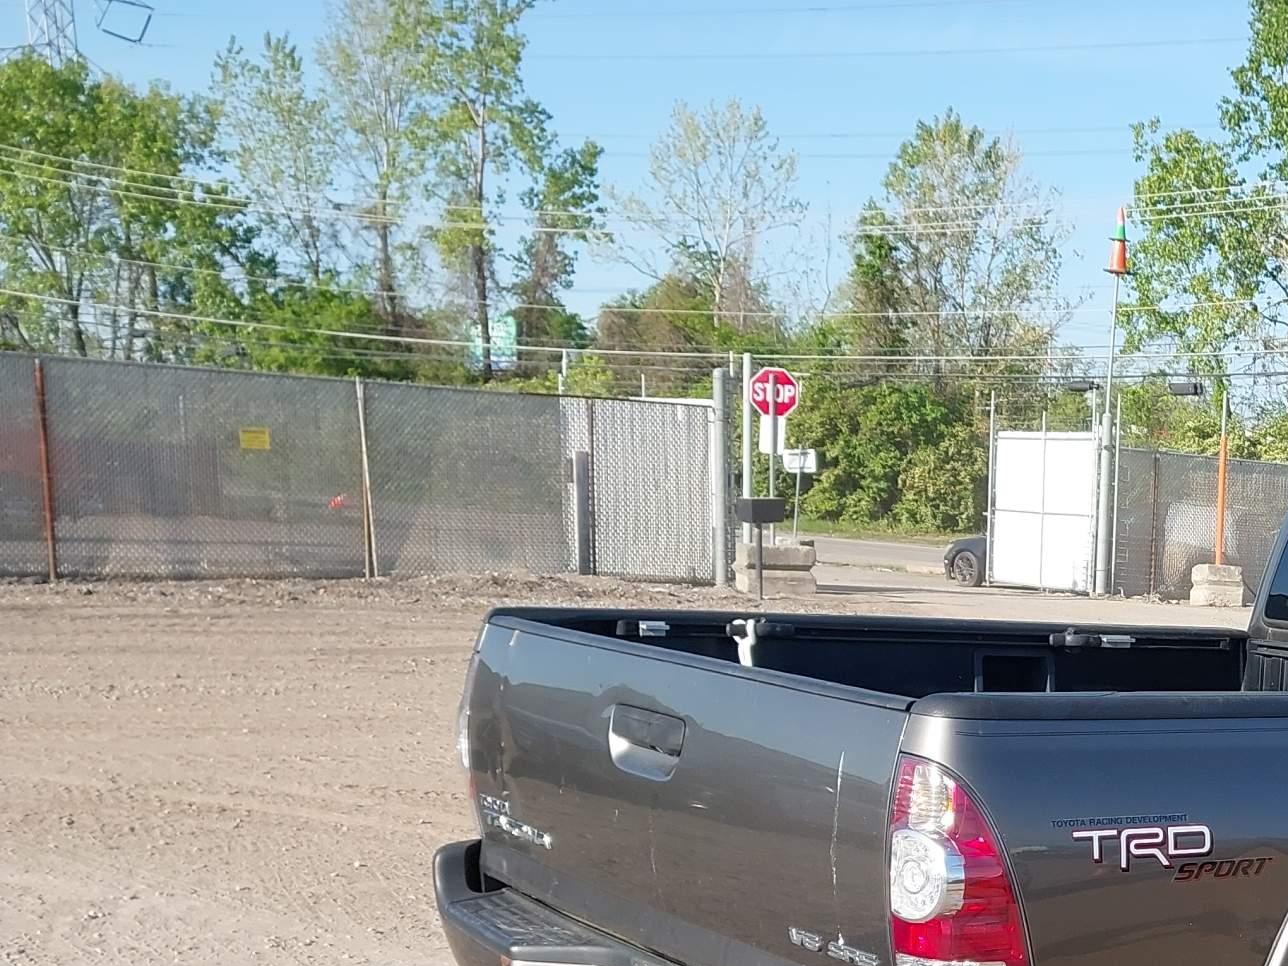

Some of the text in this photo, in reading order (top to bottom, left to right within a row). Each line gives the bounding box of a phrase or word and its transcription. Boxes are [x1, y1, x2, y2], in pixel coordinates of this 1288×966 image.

[753, 382, 796, 403] STOP
[1051, 814, 1188, 828] TOYOTA RACING DEVELOPMENT
[1071, 825, 1214, 872] TRD
[1174, 857, 1273, 881] SPORT
[788, 926, 823, 952] V6
